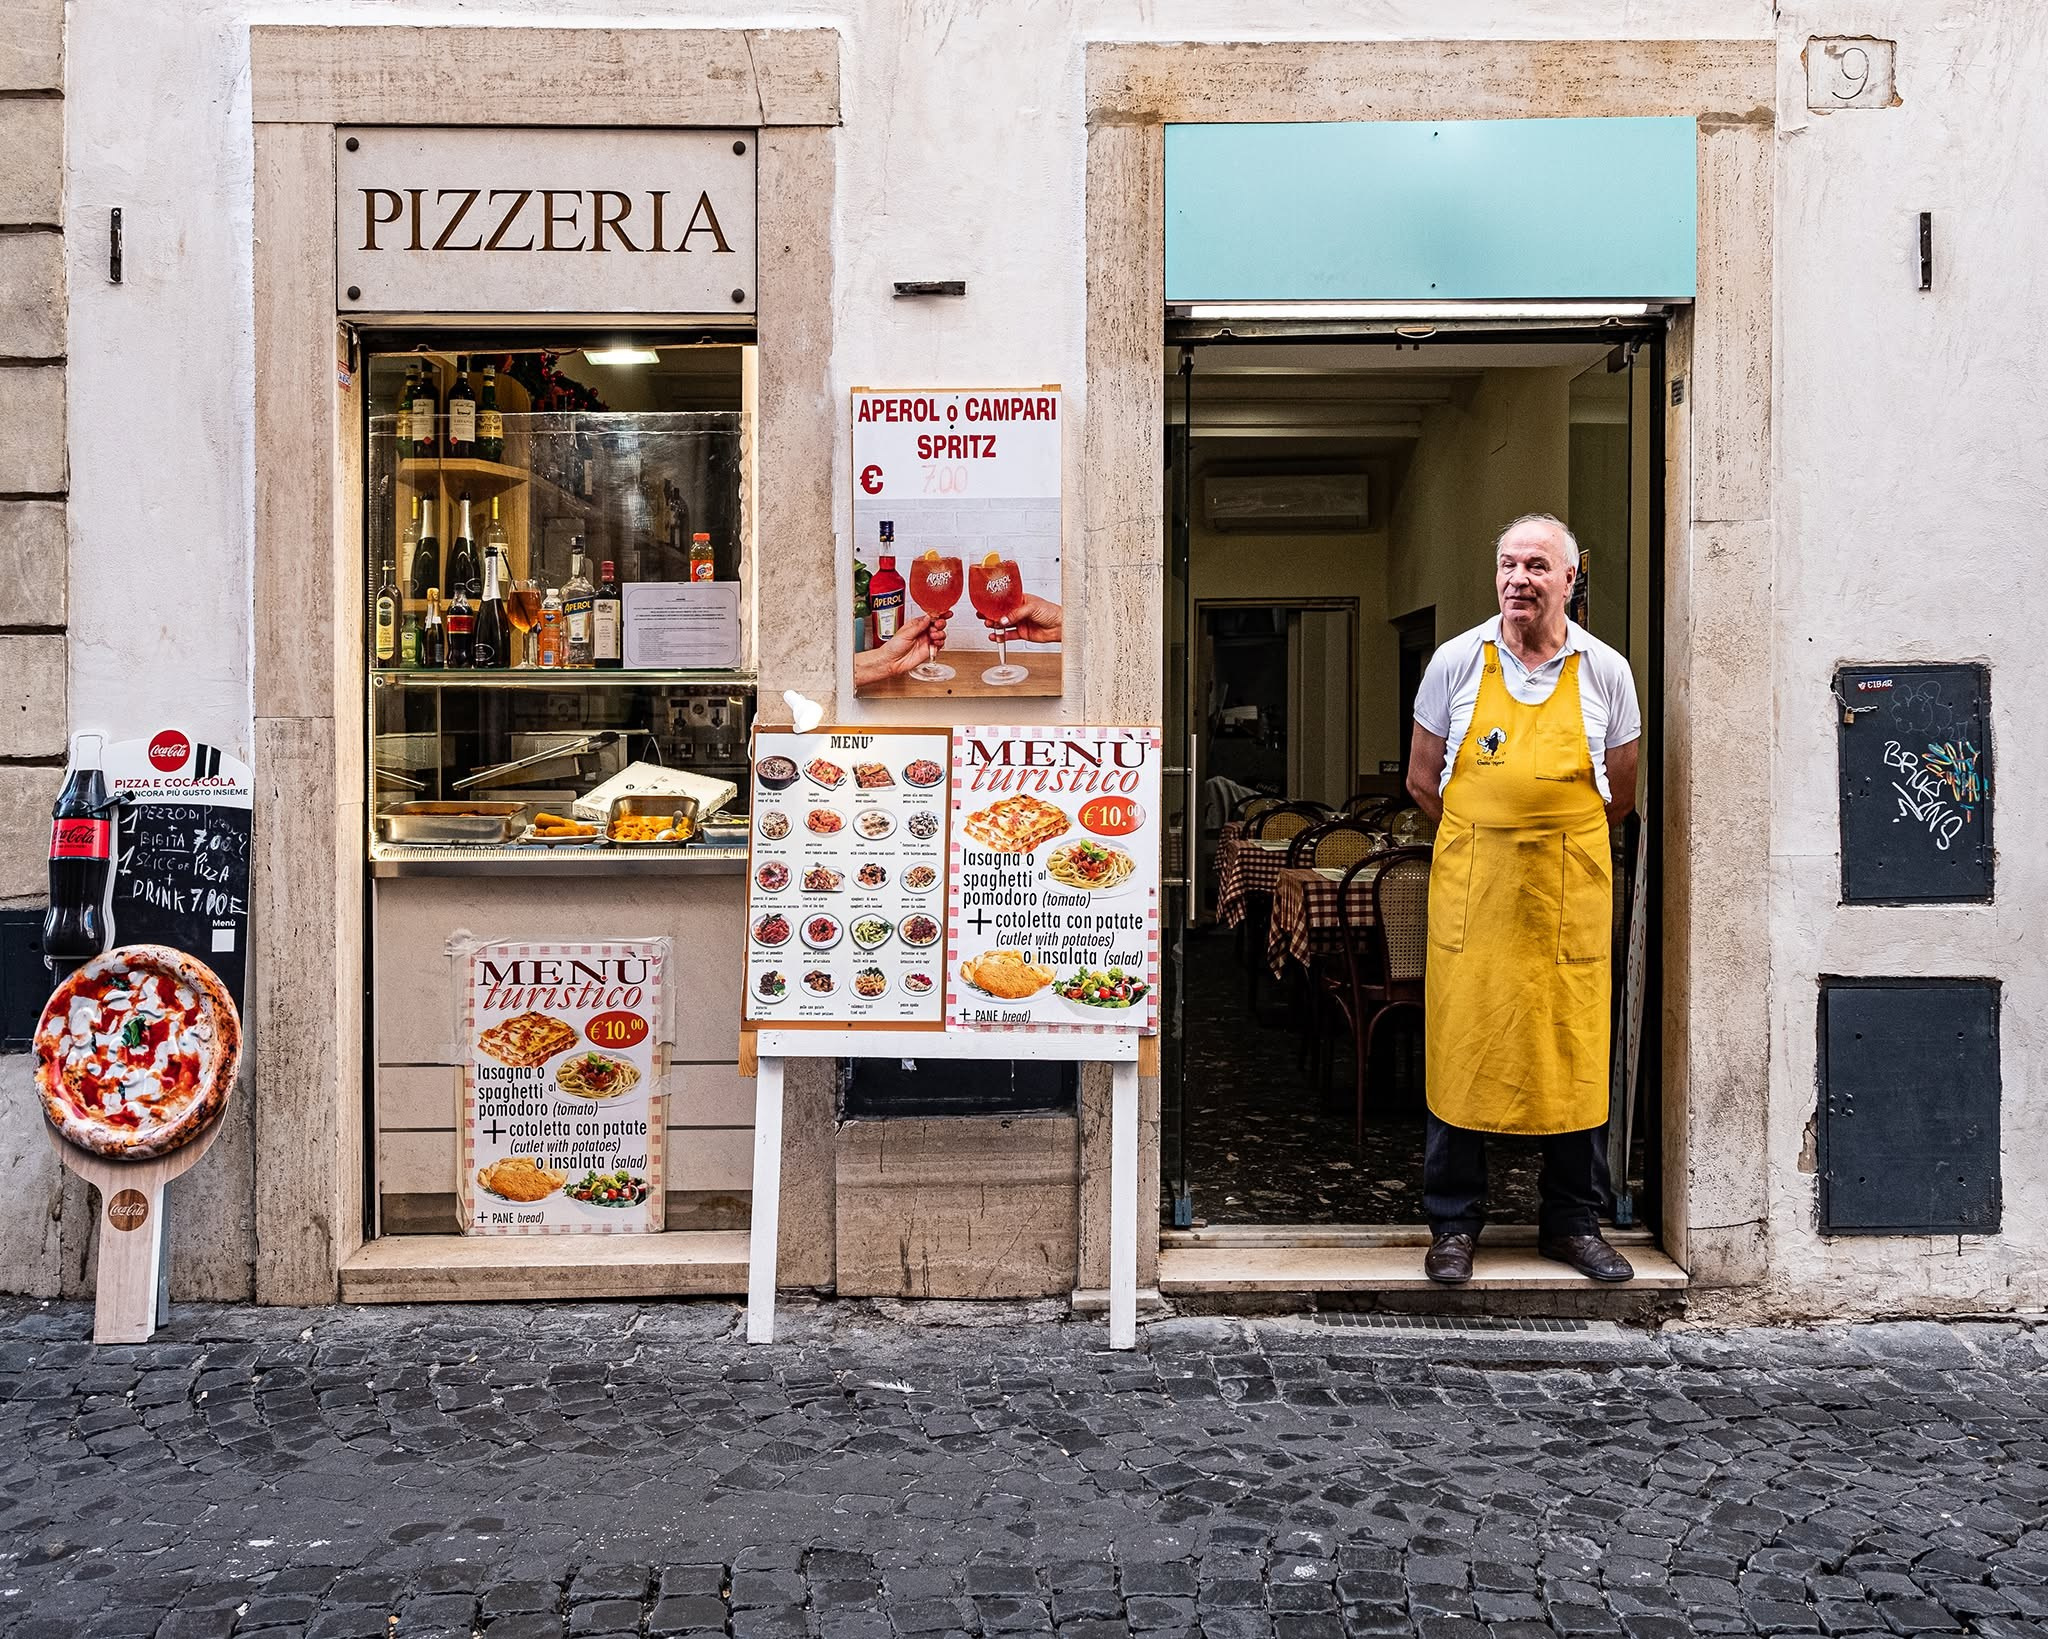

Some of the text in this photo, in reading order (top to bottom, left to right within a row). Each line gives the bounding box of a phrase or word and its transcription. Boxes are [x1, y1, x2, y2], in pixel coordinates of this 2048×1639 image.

[1831, 47, 1870, 100] 9
[357, 187, 736, 254] PIZZERIA
[858, 397, 1057, 422] APEROL o CAMPARI
[917, 434, 997, 459] SPRITZ
[859, 464, 884, 495] €
[926, 571, 952, 584] APEROL
[986, 575, 1011, 591] APEROL
[564, 601, 592, 614] APEROL
[873, 594, 902, 608] APEROL
[1867, 679, 1893, 689] EIBAR
[149, 743, 188, 758] Coca-Cola
[966, 733, 1150, 769] MENÙ
[115, 779, 150, 788] PIZZA
[153, 779, 161, 788] E
[971, 761, 1140, 794] turistico
[166, 787, 181, 796] PIÙ
[182, 788, 211, 796] GUSTO
[213, 788, 248, 796] INSIEME
[963, 848, 1035, 870] lasagna o
[963, 870, 1046, 891] spaghetti al
[963, 888, 1091, 908] pomodoro (tomato)
[212, 918, 236, 928] Menù
[995, 912, 1061, 928] cotoletta
[1067, 915, 1092, 928] con
[1096, 913, 1143, 932] patate
[996, 930, 1115, 948] (cutlet with potatoes)
[1023, 947, 1143, 967] o insalata (salad)
[477, 951, 651, 986] MENÙ
[483, 980, 643, 1010] turistico
[975, 1009, 998, 1022] PANE
[1002, 1009, 1031, 1023] bread)
[477, 1064, 545, 1083] lasagna o
[478, 1082, 556, 1103] spaghetti al
[479, 1100, 599, 1120] pomodoro (tomato)
[509, 1120, 571, 1136] cotoletta
[576, 1123, 599, 1136] con
[603, 1121, 647, 1139] patate
[510, 1138, 621, 1155] (cutlet with potatoes)
[536, 1153, 648, 1170] o insalata (salad)
[492, 1212, 514, 1223] PANE
[517, 1211, 544, 1224] bread)
